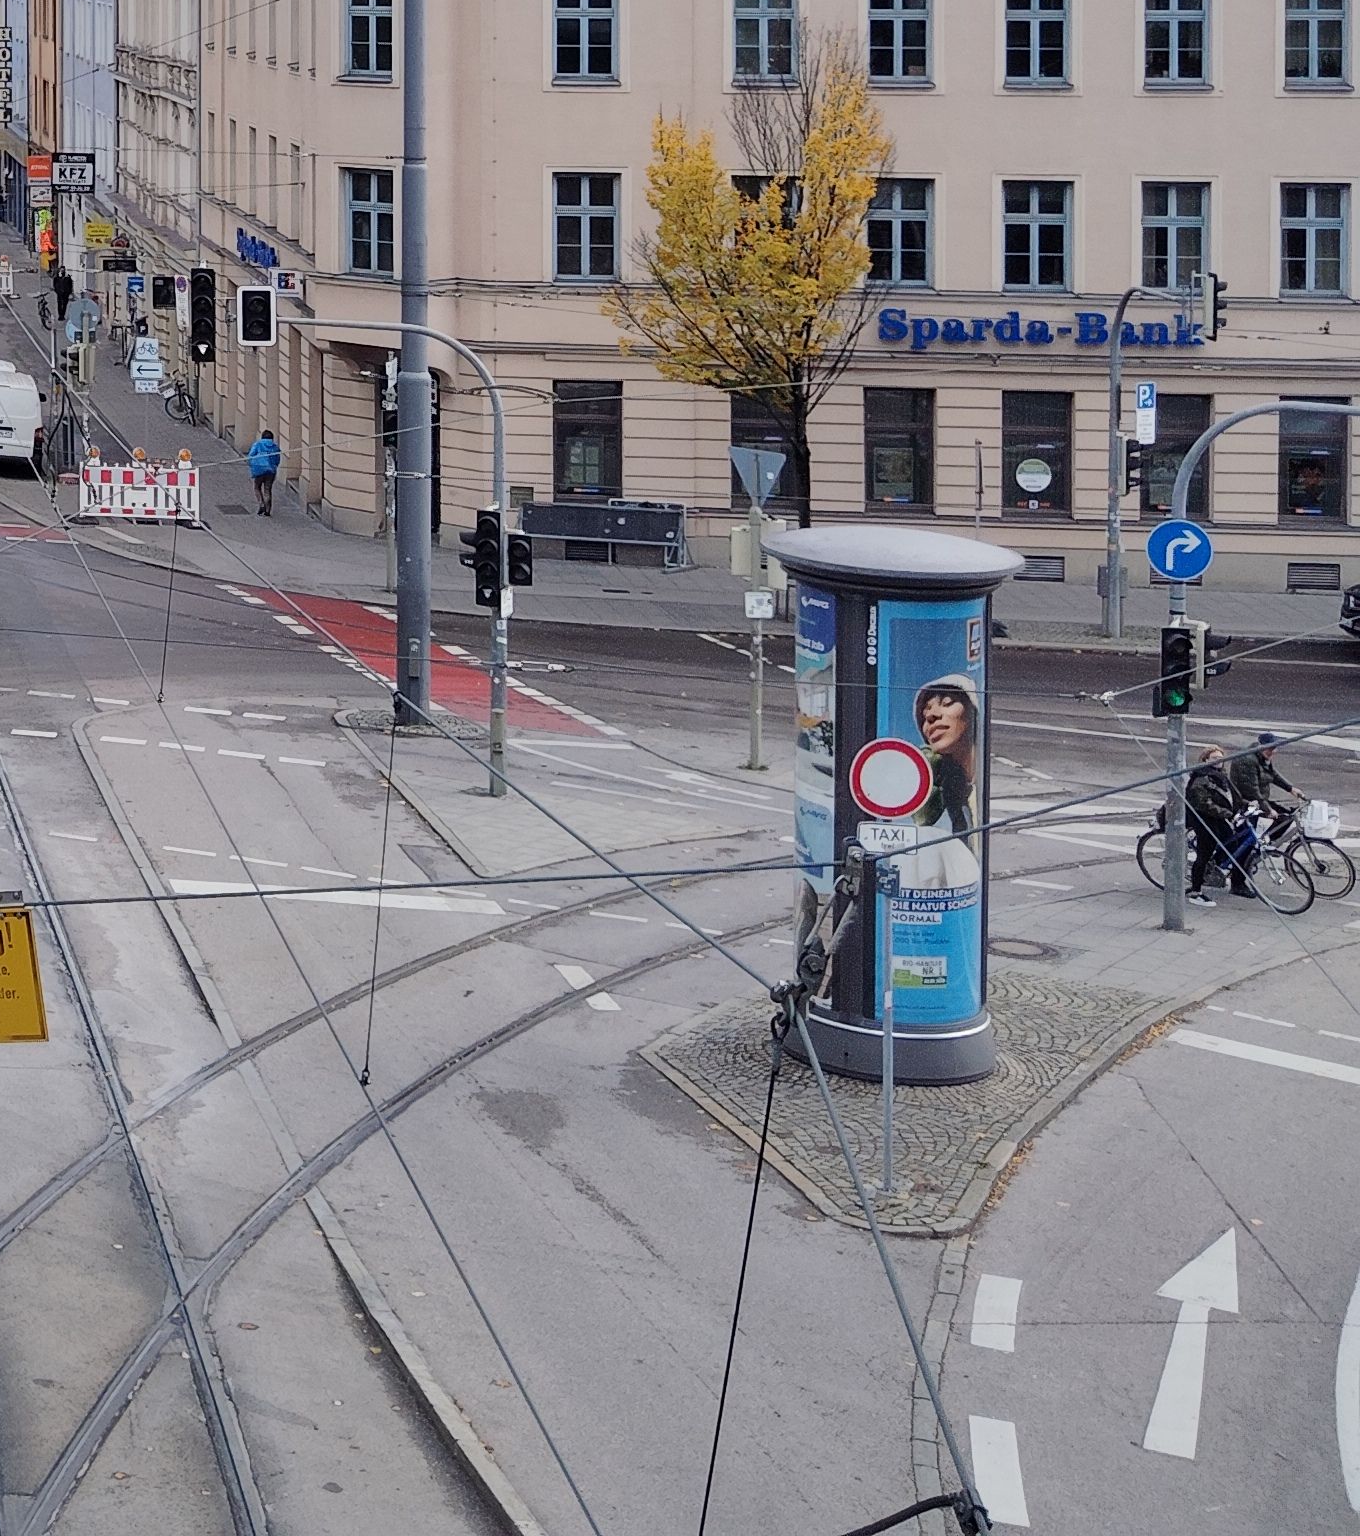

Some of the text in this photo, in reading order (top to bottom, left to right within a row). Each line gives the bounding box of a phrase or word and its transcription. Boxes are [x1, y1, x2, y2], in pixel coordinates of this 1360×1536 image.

[59, 167, 86, 179] KFZ
[879, 308, 1205, 350] Sparda-Bank
[871, 827, 905, 842] TAXI
[913, 889, 953, 899] DEINEM
[891, 900, 909, 910] DIE
[912, 902, 946, 911] NATUR
